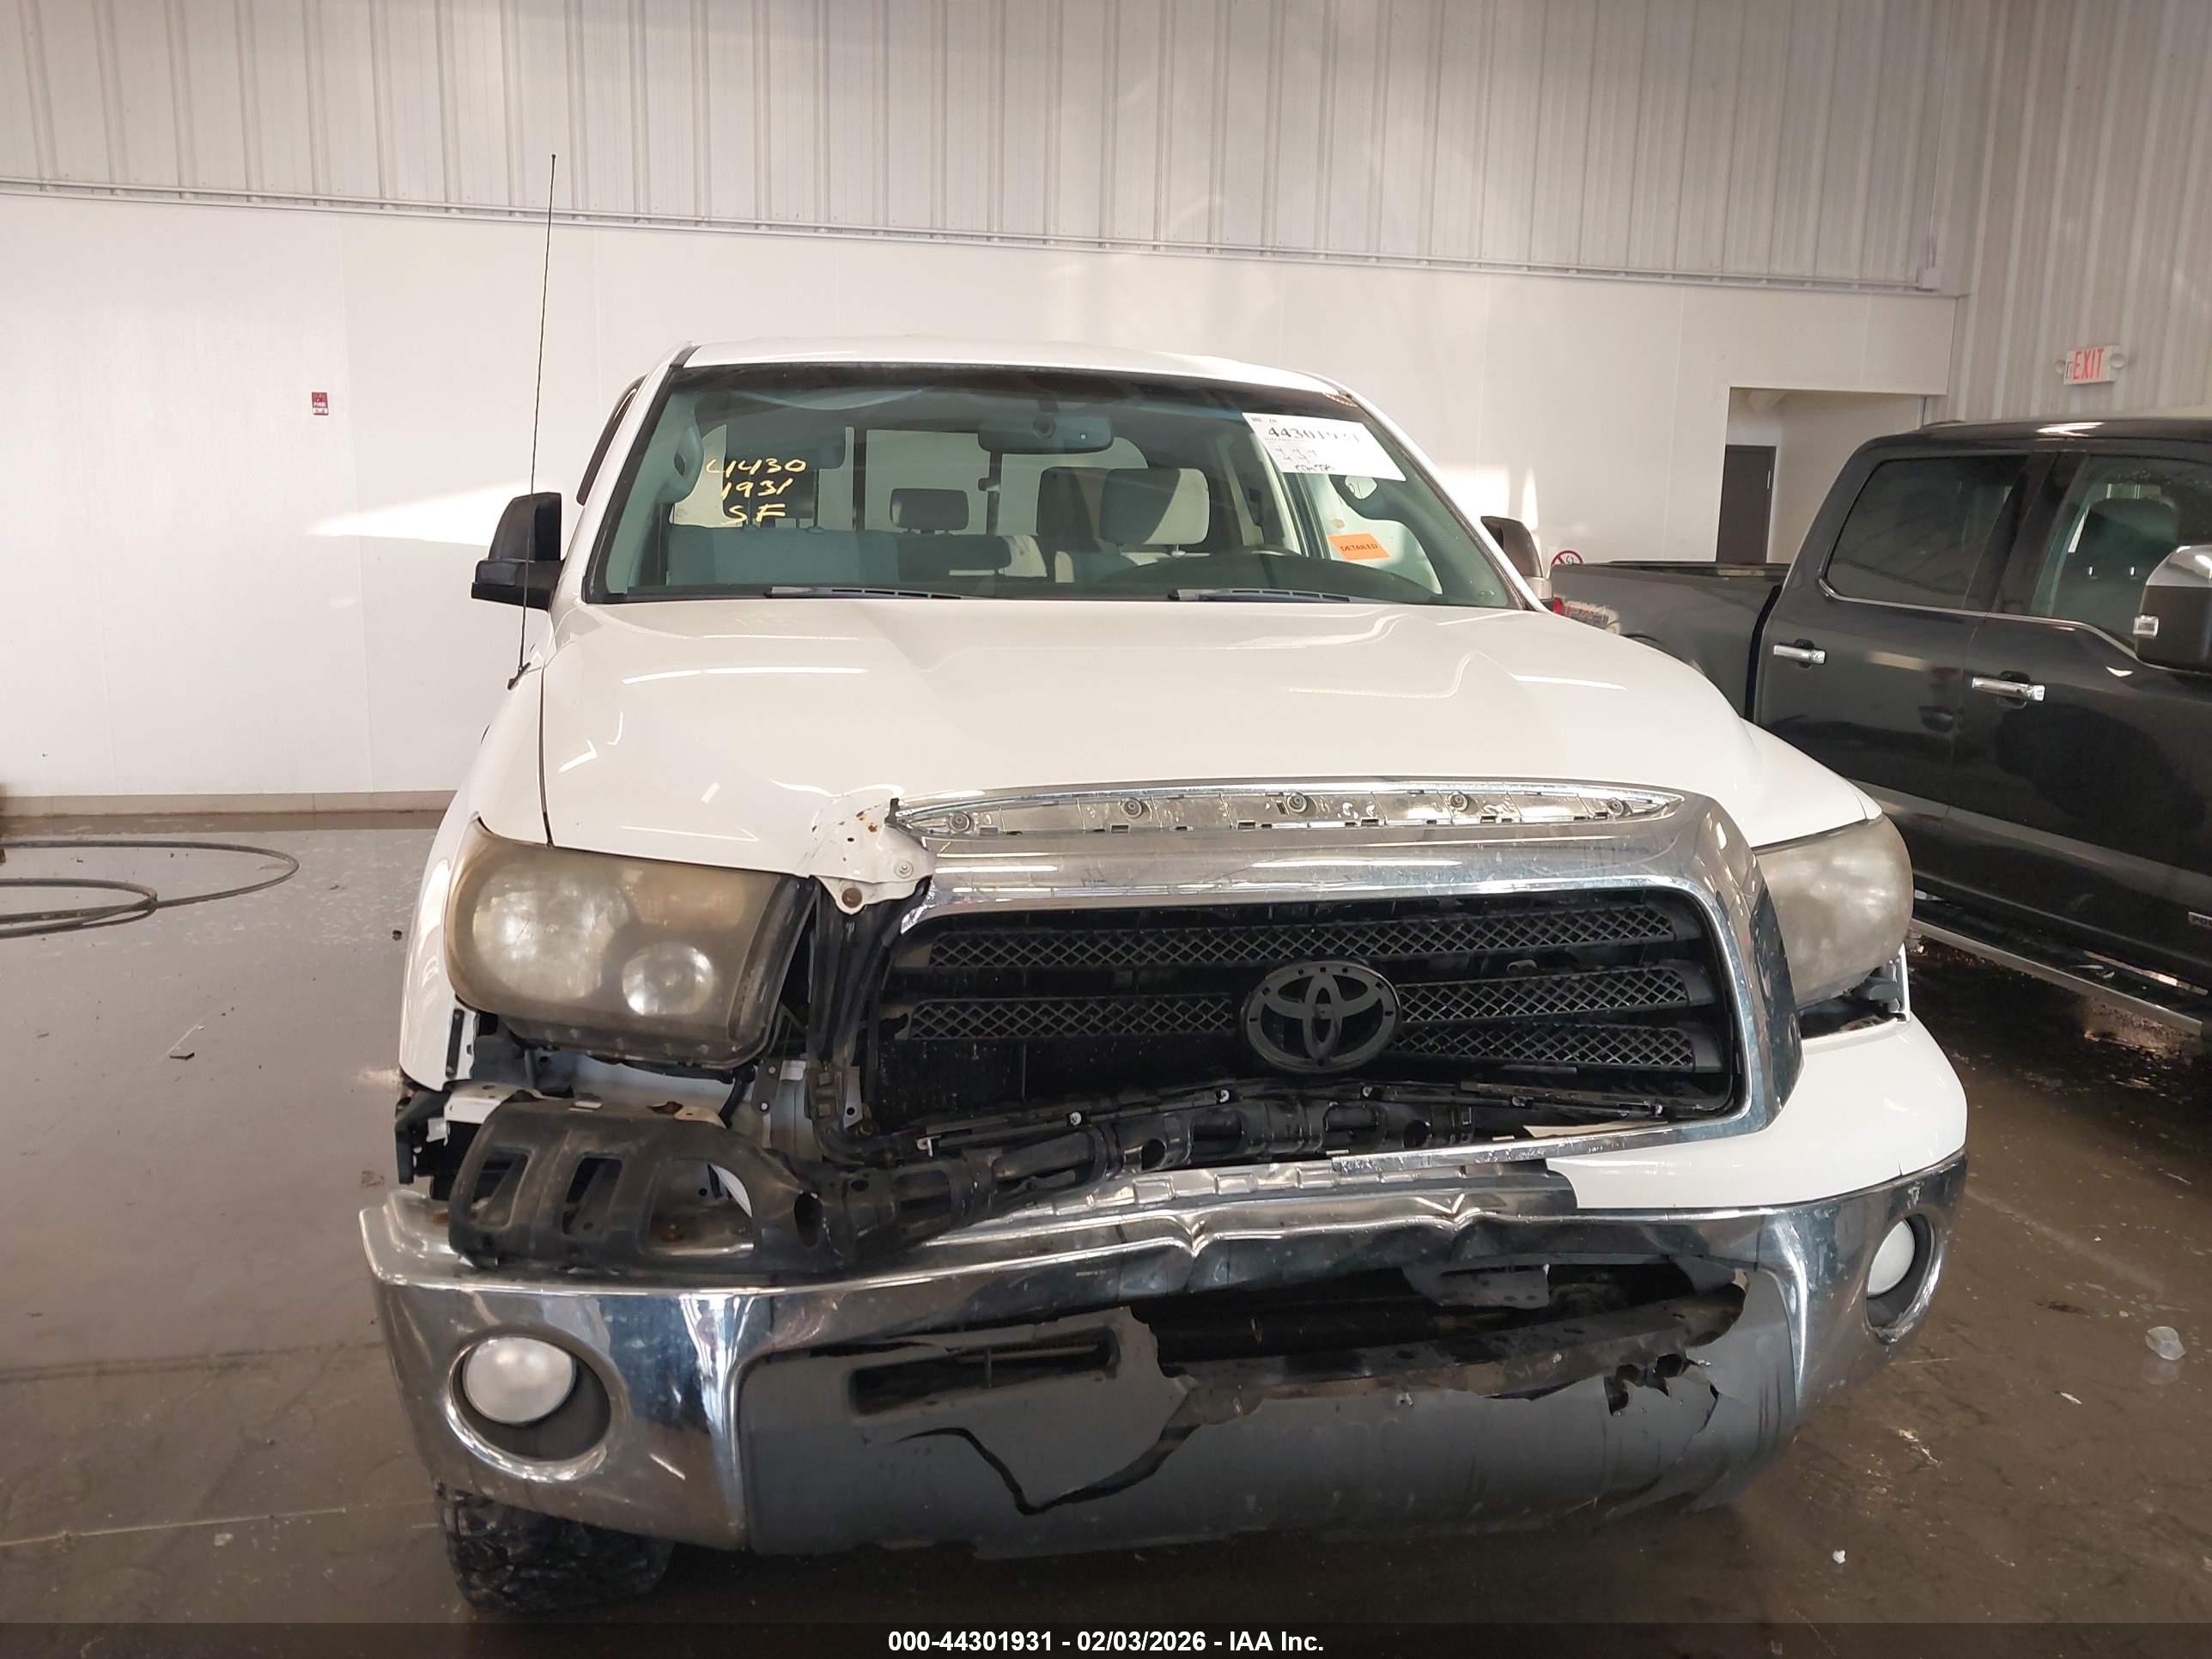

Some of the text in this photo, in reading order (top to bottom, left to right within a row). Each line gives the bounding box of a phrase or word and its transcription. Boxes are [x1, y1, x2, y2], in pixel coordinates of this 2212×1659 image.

[2073, 348, 2104, 380] EXIT
[706, 458, 806, 478] 4430
[721, 477, 793, 501] 1931
[1340, 544, 1378, 552] DETAILED
